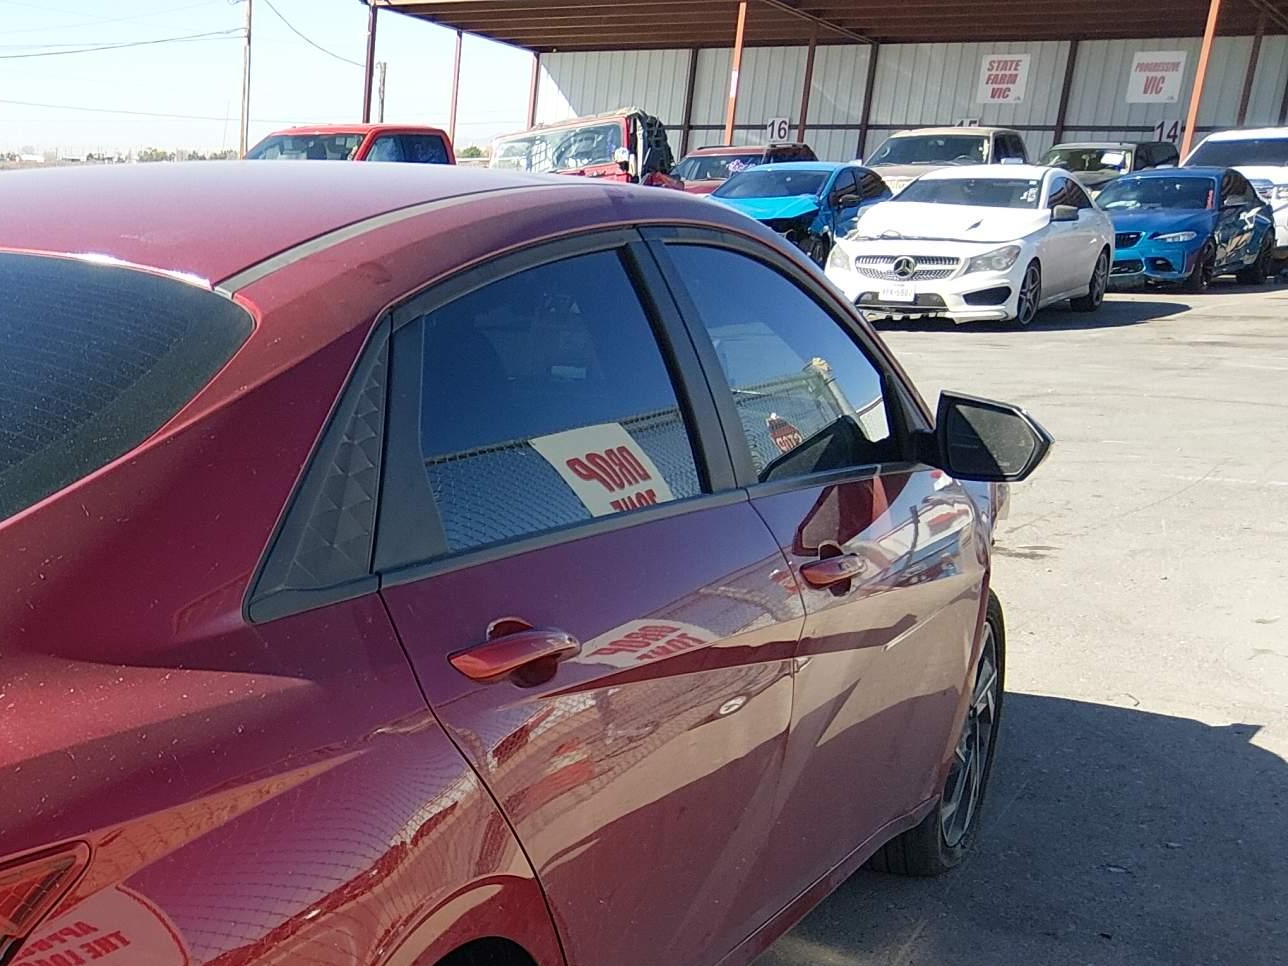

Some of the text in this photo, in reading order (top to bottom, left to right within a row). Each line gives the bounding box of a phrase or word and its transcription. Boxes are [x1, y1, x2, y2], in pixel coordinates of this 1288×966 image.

[987, 59, 1023, 72] STATE
[1135, 61, 1182, 73] PROGRESSIVE
[985, 73, 1019, 85] FARM
[1143, 75, 1166, 95] VIC
[990, 87, 1011, 99] VIC
[768, 119, 788, 139] 16
[1156, 120, 1179, 143] 14
